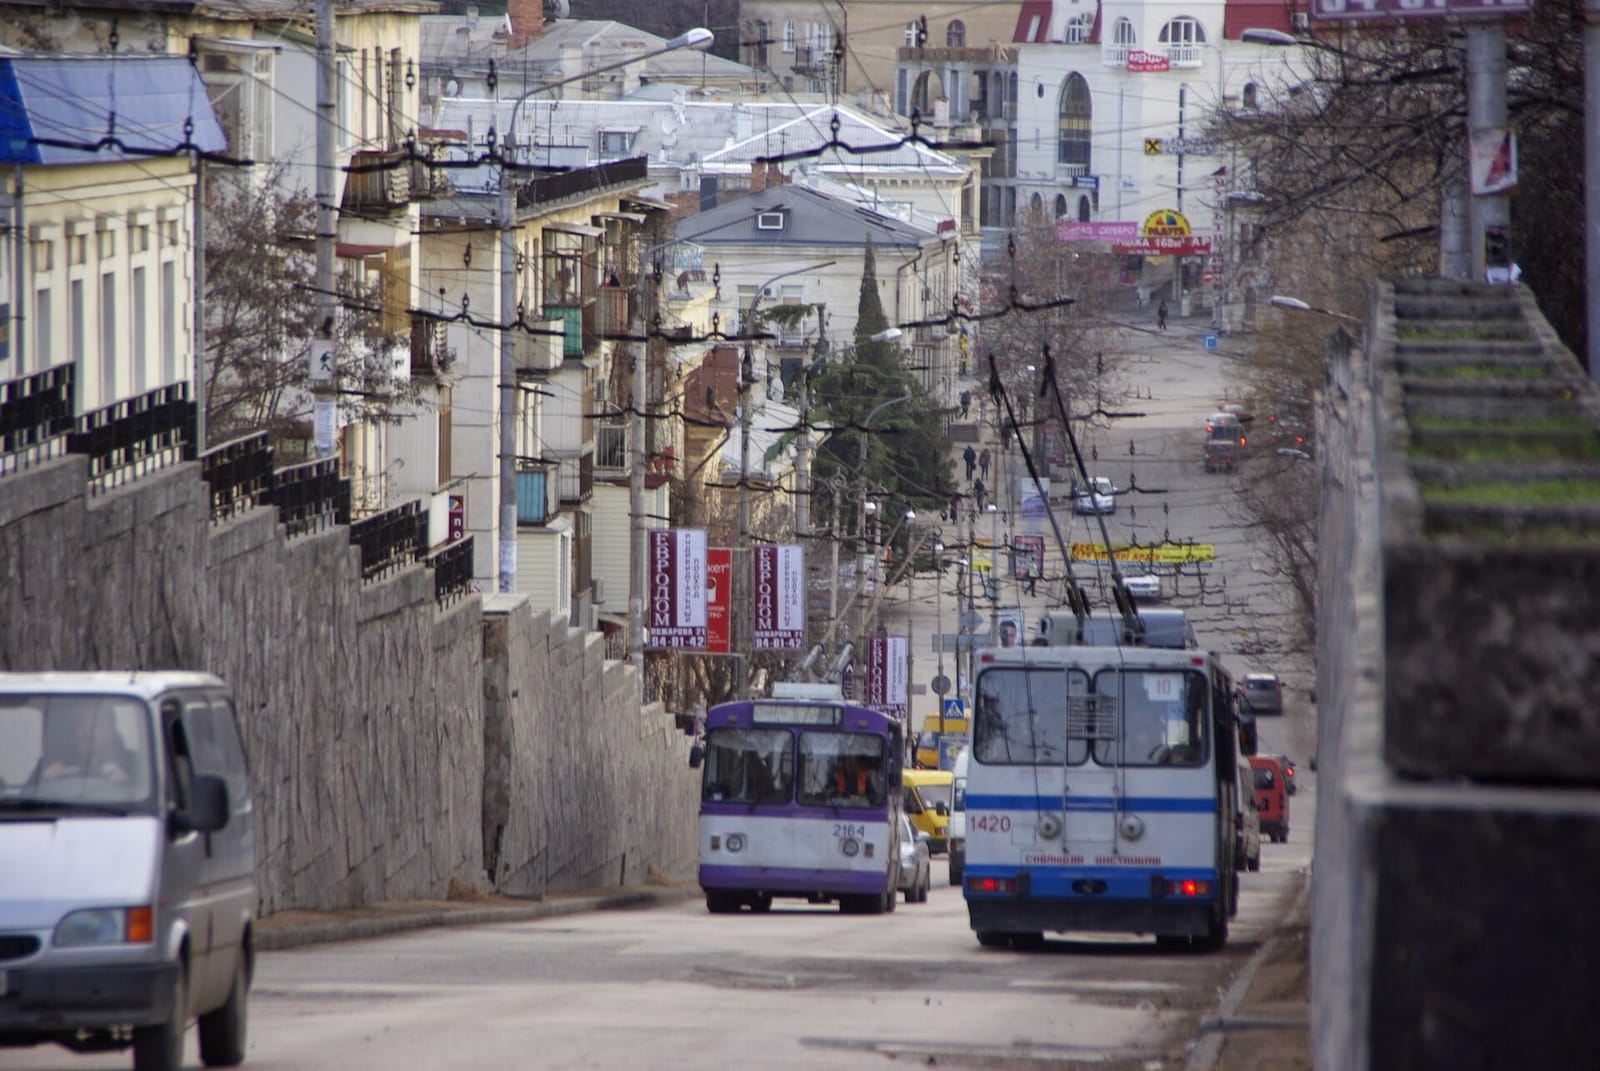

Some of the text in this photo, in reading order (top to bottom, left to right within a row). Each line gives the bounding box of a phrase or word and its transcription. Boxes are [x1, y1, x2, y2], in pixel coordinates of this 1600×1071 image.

[655, 532, 670, 627] ЕВРОДОМ
[758, 548, 772, 630] ЕВРОДОМ
[833, 823, 865, 839] 2164
[969, 815, 1012, 833] 1420
